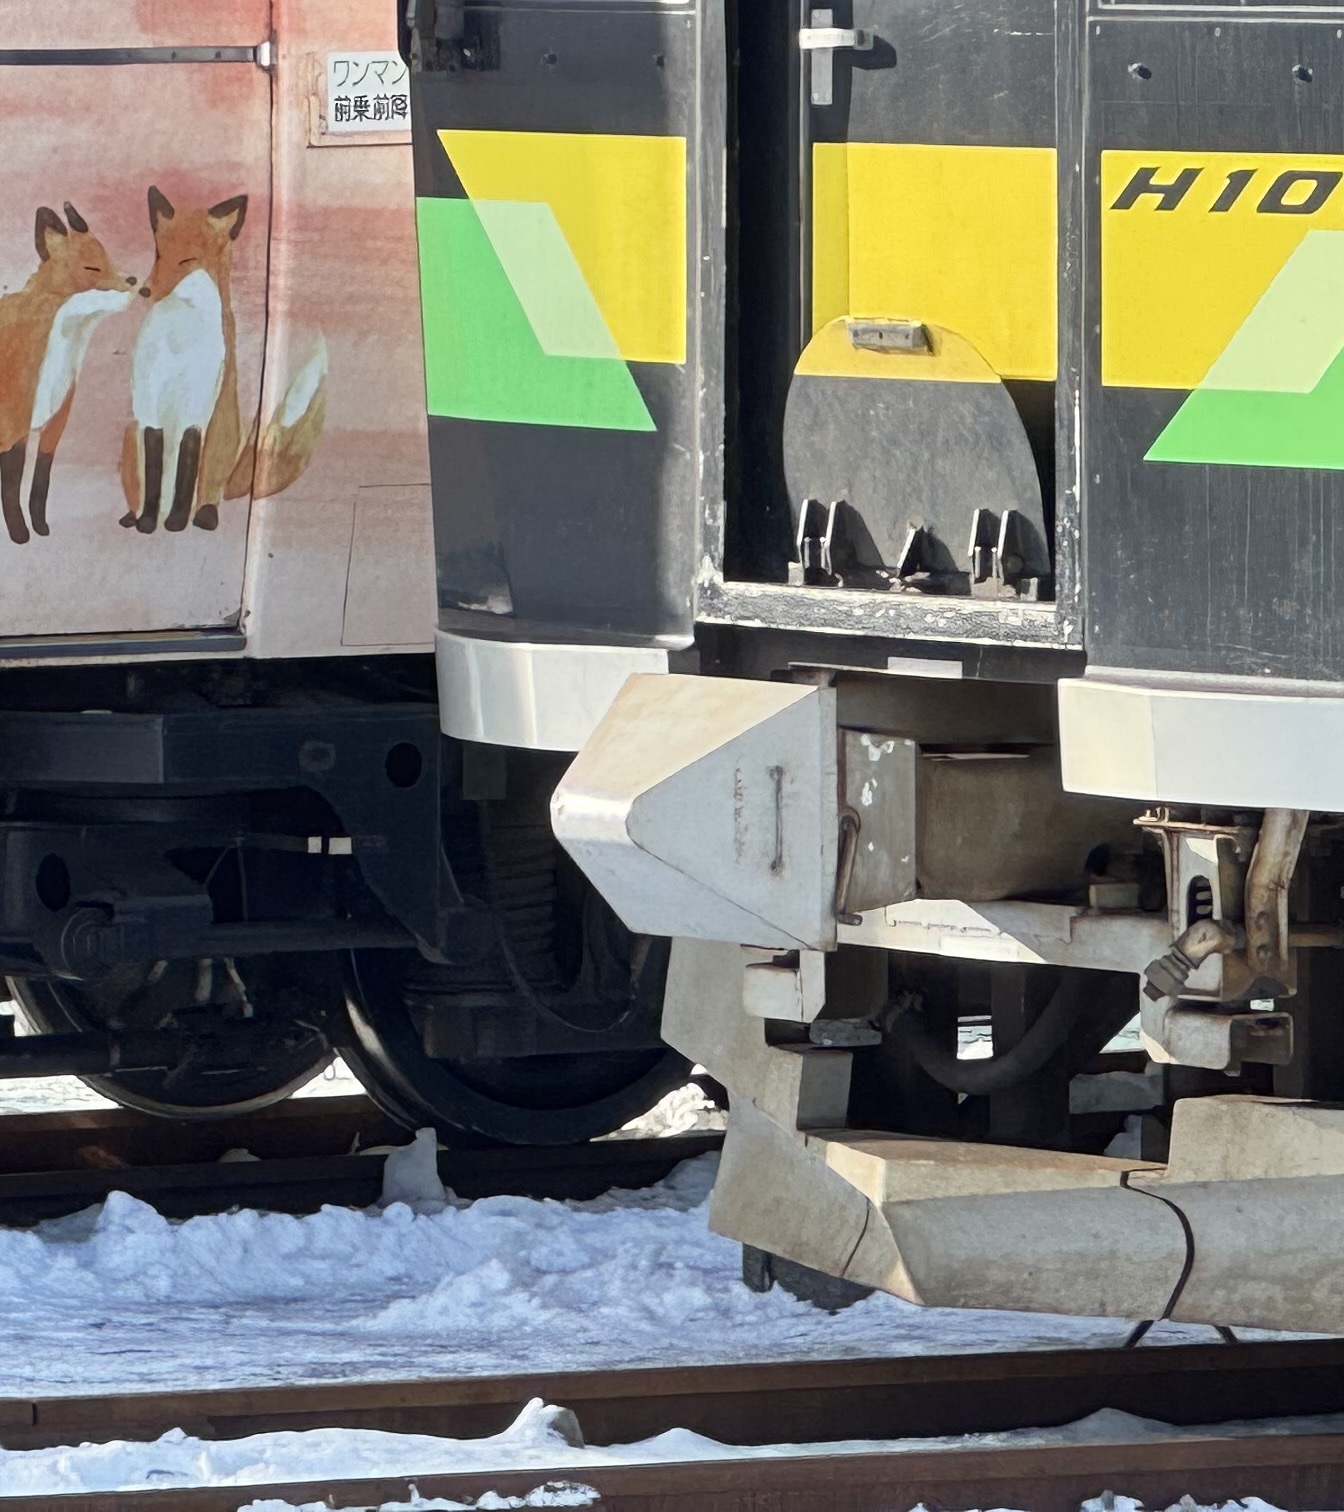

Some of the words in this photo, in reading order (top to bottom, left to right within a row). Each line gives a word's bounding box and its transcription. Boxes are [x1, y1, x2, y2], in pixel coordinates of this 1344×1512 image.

[333, 60, 409, 88] ワンマン
[1109, 166, 1344, 215] H10
